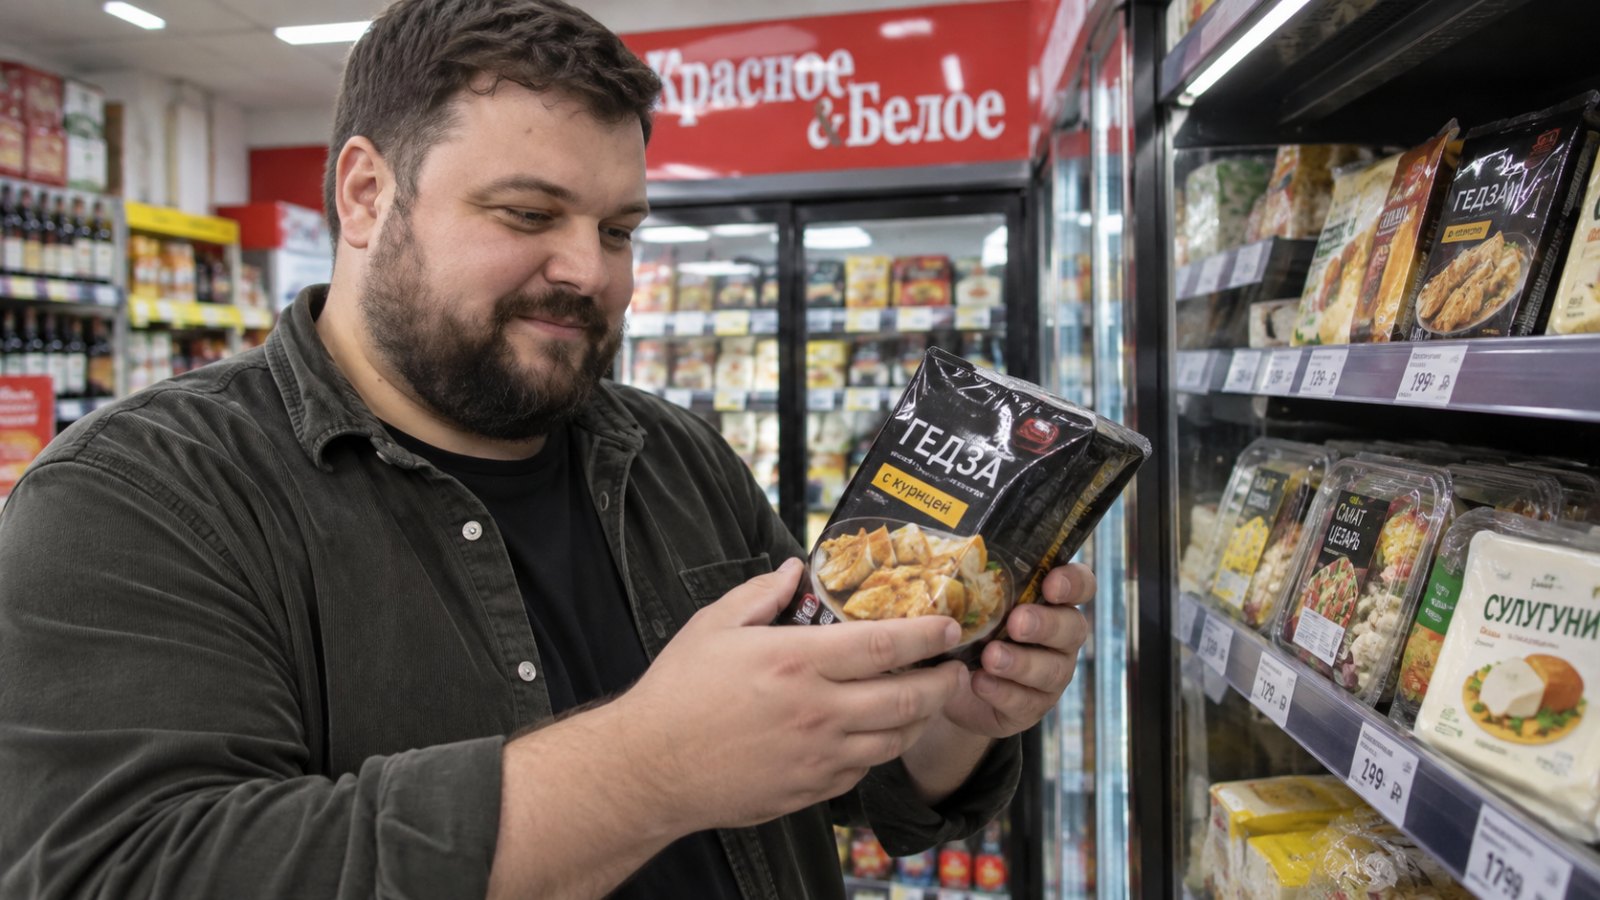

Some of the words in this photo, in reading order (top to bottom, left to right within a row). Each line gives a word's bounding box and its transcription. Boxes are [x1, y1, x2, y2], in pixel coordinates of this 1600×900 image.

[645, 48, 855, 127] Красное
[846, 81, 1006, 147] Белое
[898, 417, 1002, 489] ГЕДЗА
[1483, 593, 1600, 641] СУЛУГУНИ
